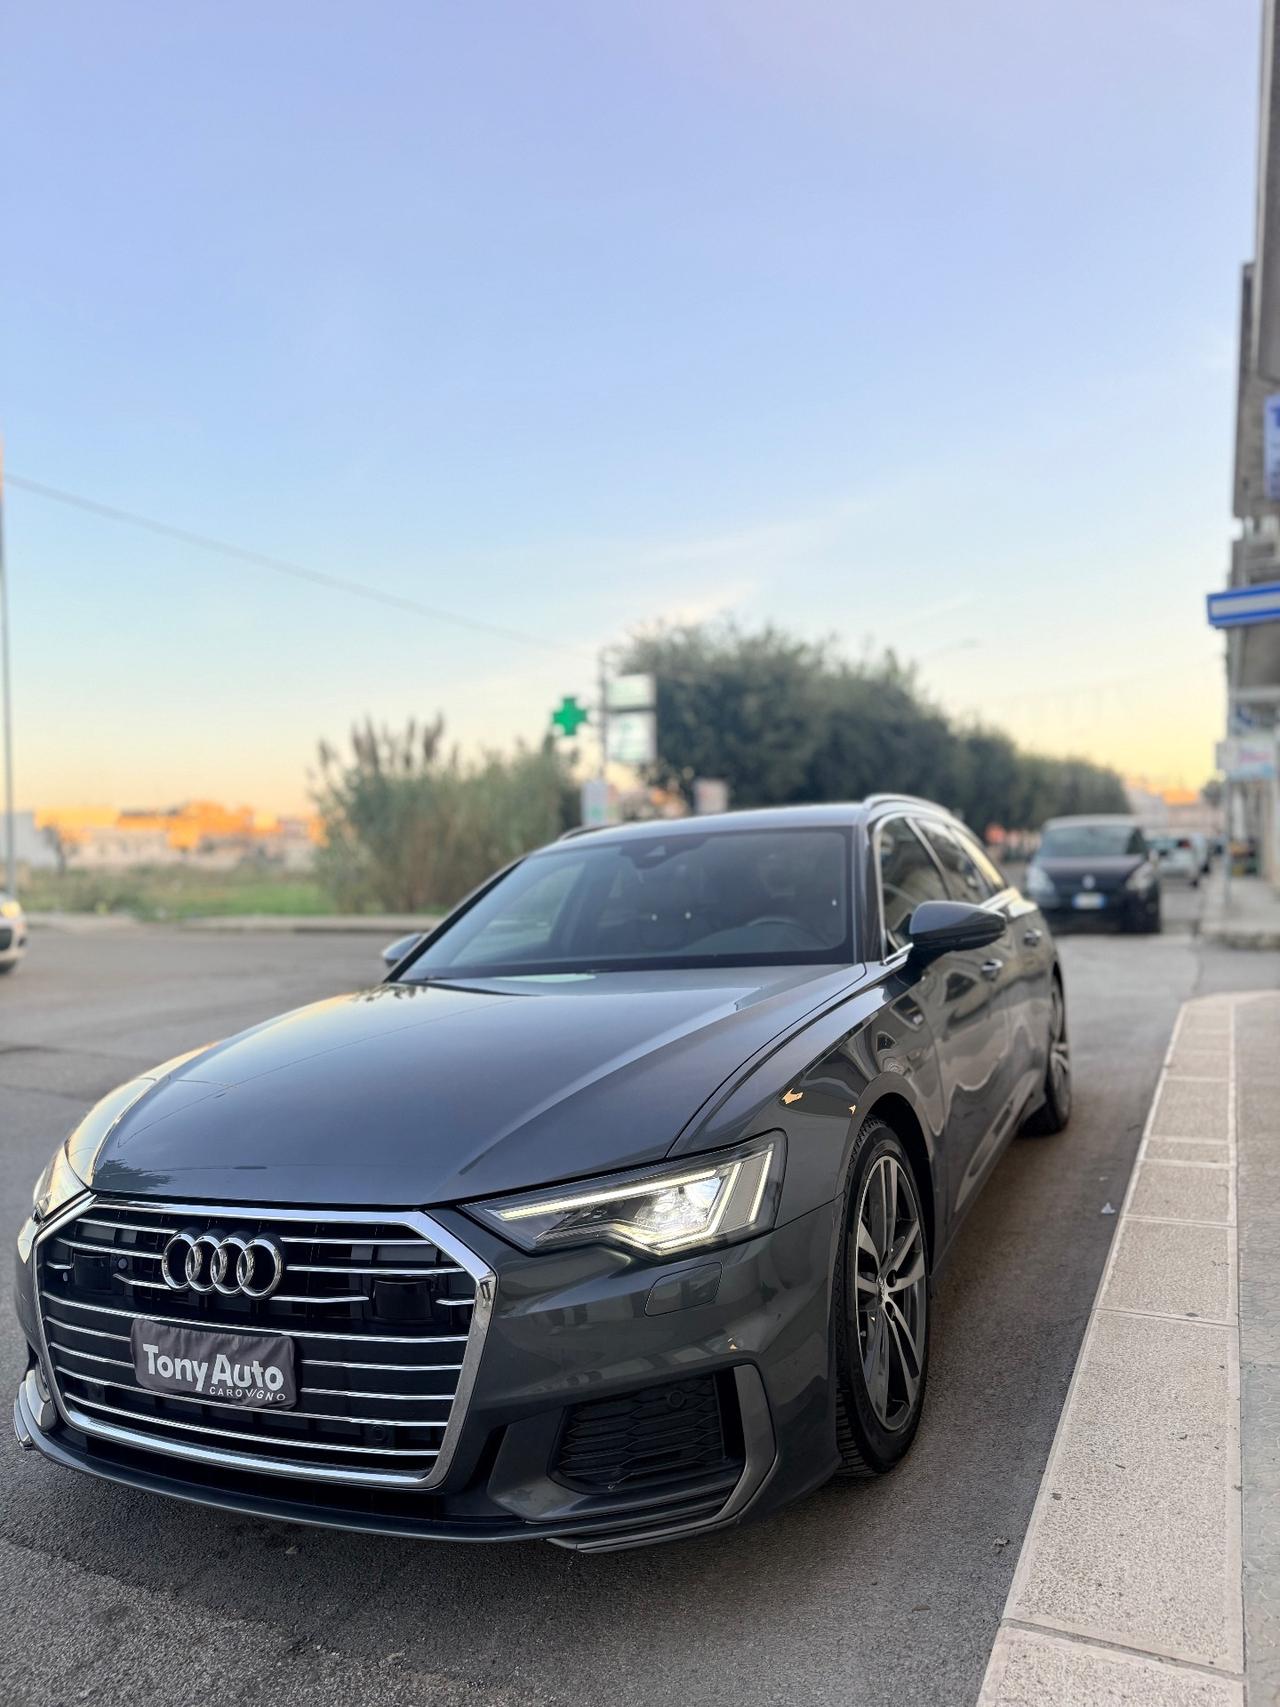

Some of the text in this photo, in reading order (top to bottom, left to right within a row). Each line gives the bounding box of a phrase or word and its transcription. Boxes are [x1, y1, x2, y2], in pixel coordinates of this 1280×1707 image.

[143, 1344, 285, 1391] Tony Auto
[210, 1386, 286, 1401] CAROVIGNO
